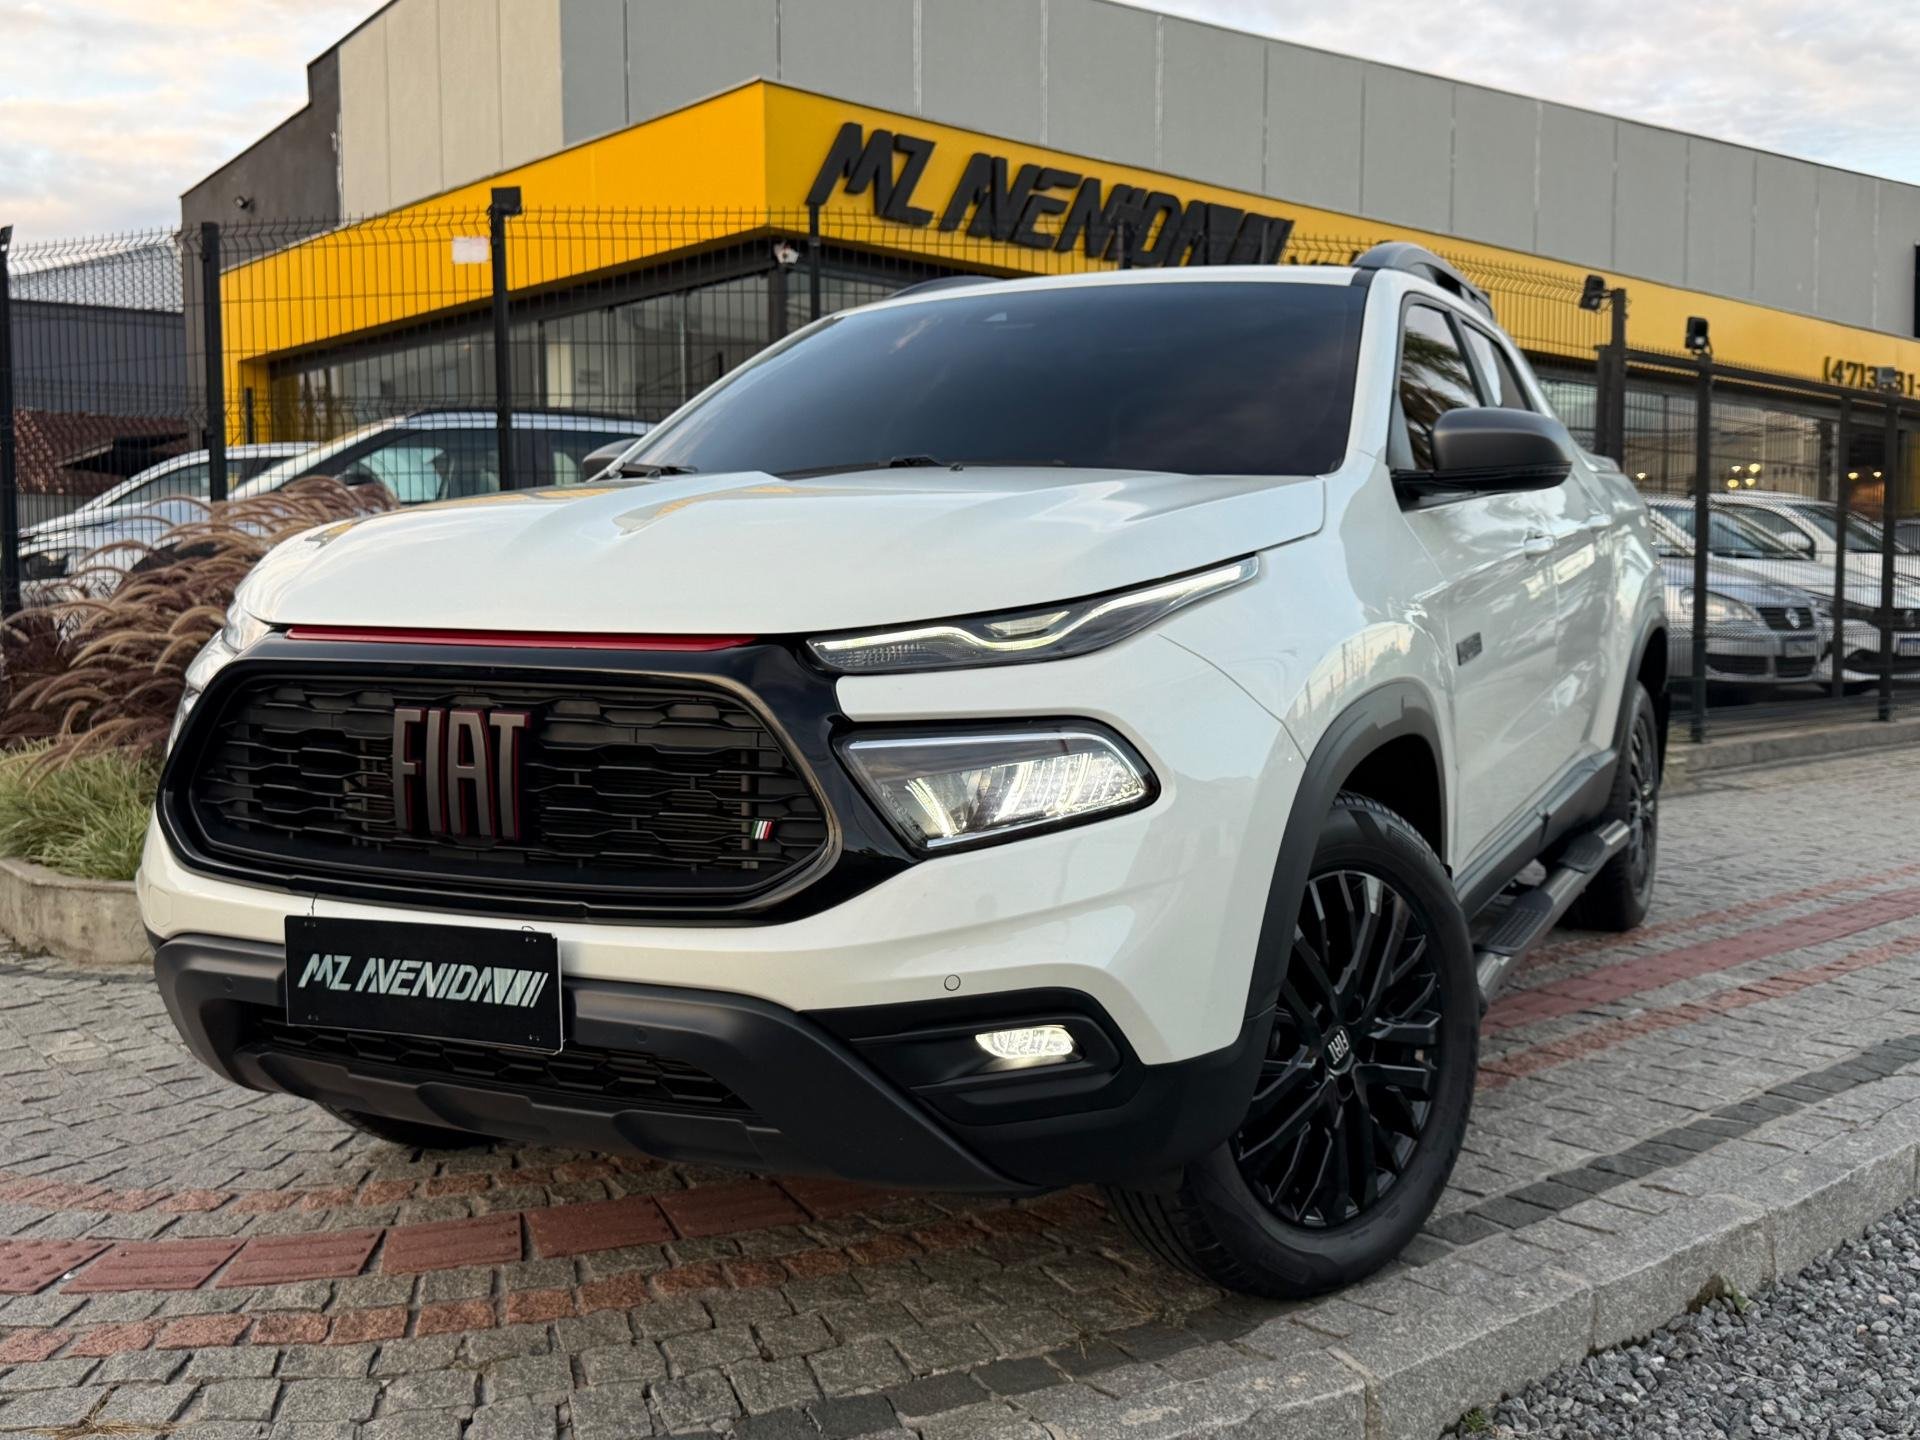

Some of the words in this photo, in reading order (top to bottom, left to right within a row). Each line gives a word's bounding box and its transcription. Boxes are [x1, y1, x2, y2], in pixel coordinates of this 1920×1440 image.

[806, 122, 936, 227] MZ
[1823, 356, 1920, 395] (47)331-
[393, 707, 529, 840] FIAT
[298, 953, 351, 991] MZ
[355, 957, 548, 1008] AVENIDA
[1328, 1030, 1349, 1065] FIAT
